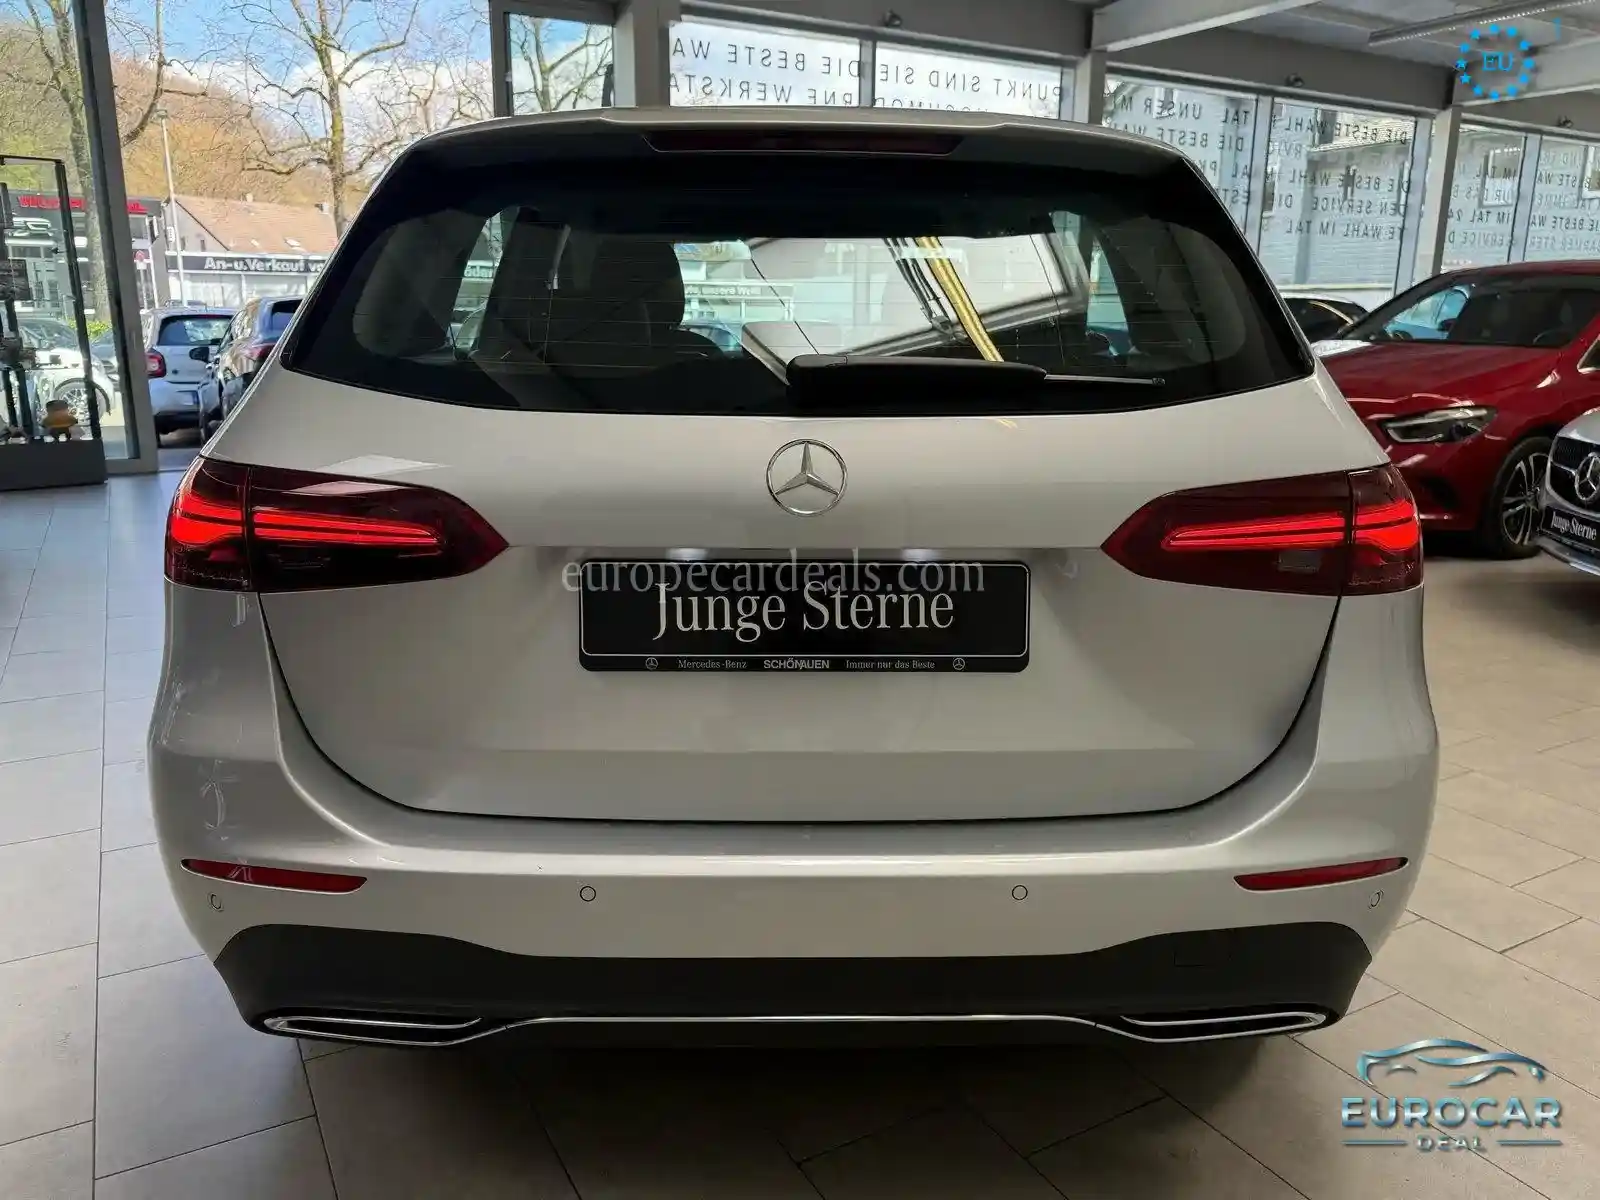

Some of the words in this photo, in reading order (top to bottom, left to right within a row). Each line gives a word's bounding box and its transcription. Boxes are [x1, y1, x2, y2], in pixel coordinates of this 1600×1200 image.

[1570, 517, 1597, 541] Sterne
[652, 582, 786, 643] Junge
[803, 580, 954, 631] Sterne
[678, 659, 747, 669] Mercedes-Benz
[763, 657, 830, 669] SCHÖNAUEN
[846, 660, 874, 669] Immer
[877, 661, 892, 669] nur
[894, 660, 910, 669] das
[912, 660, 936, 669] Beste
